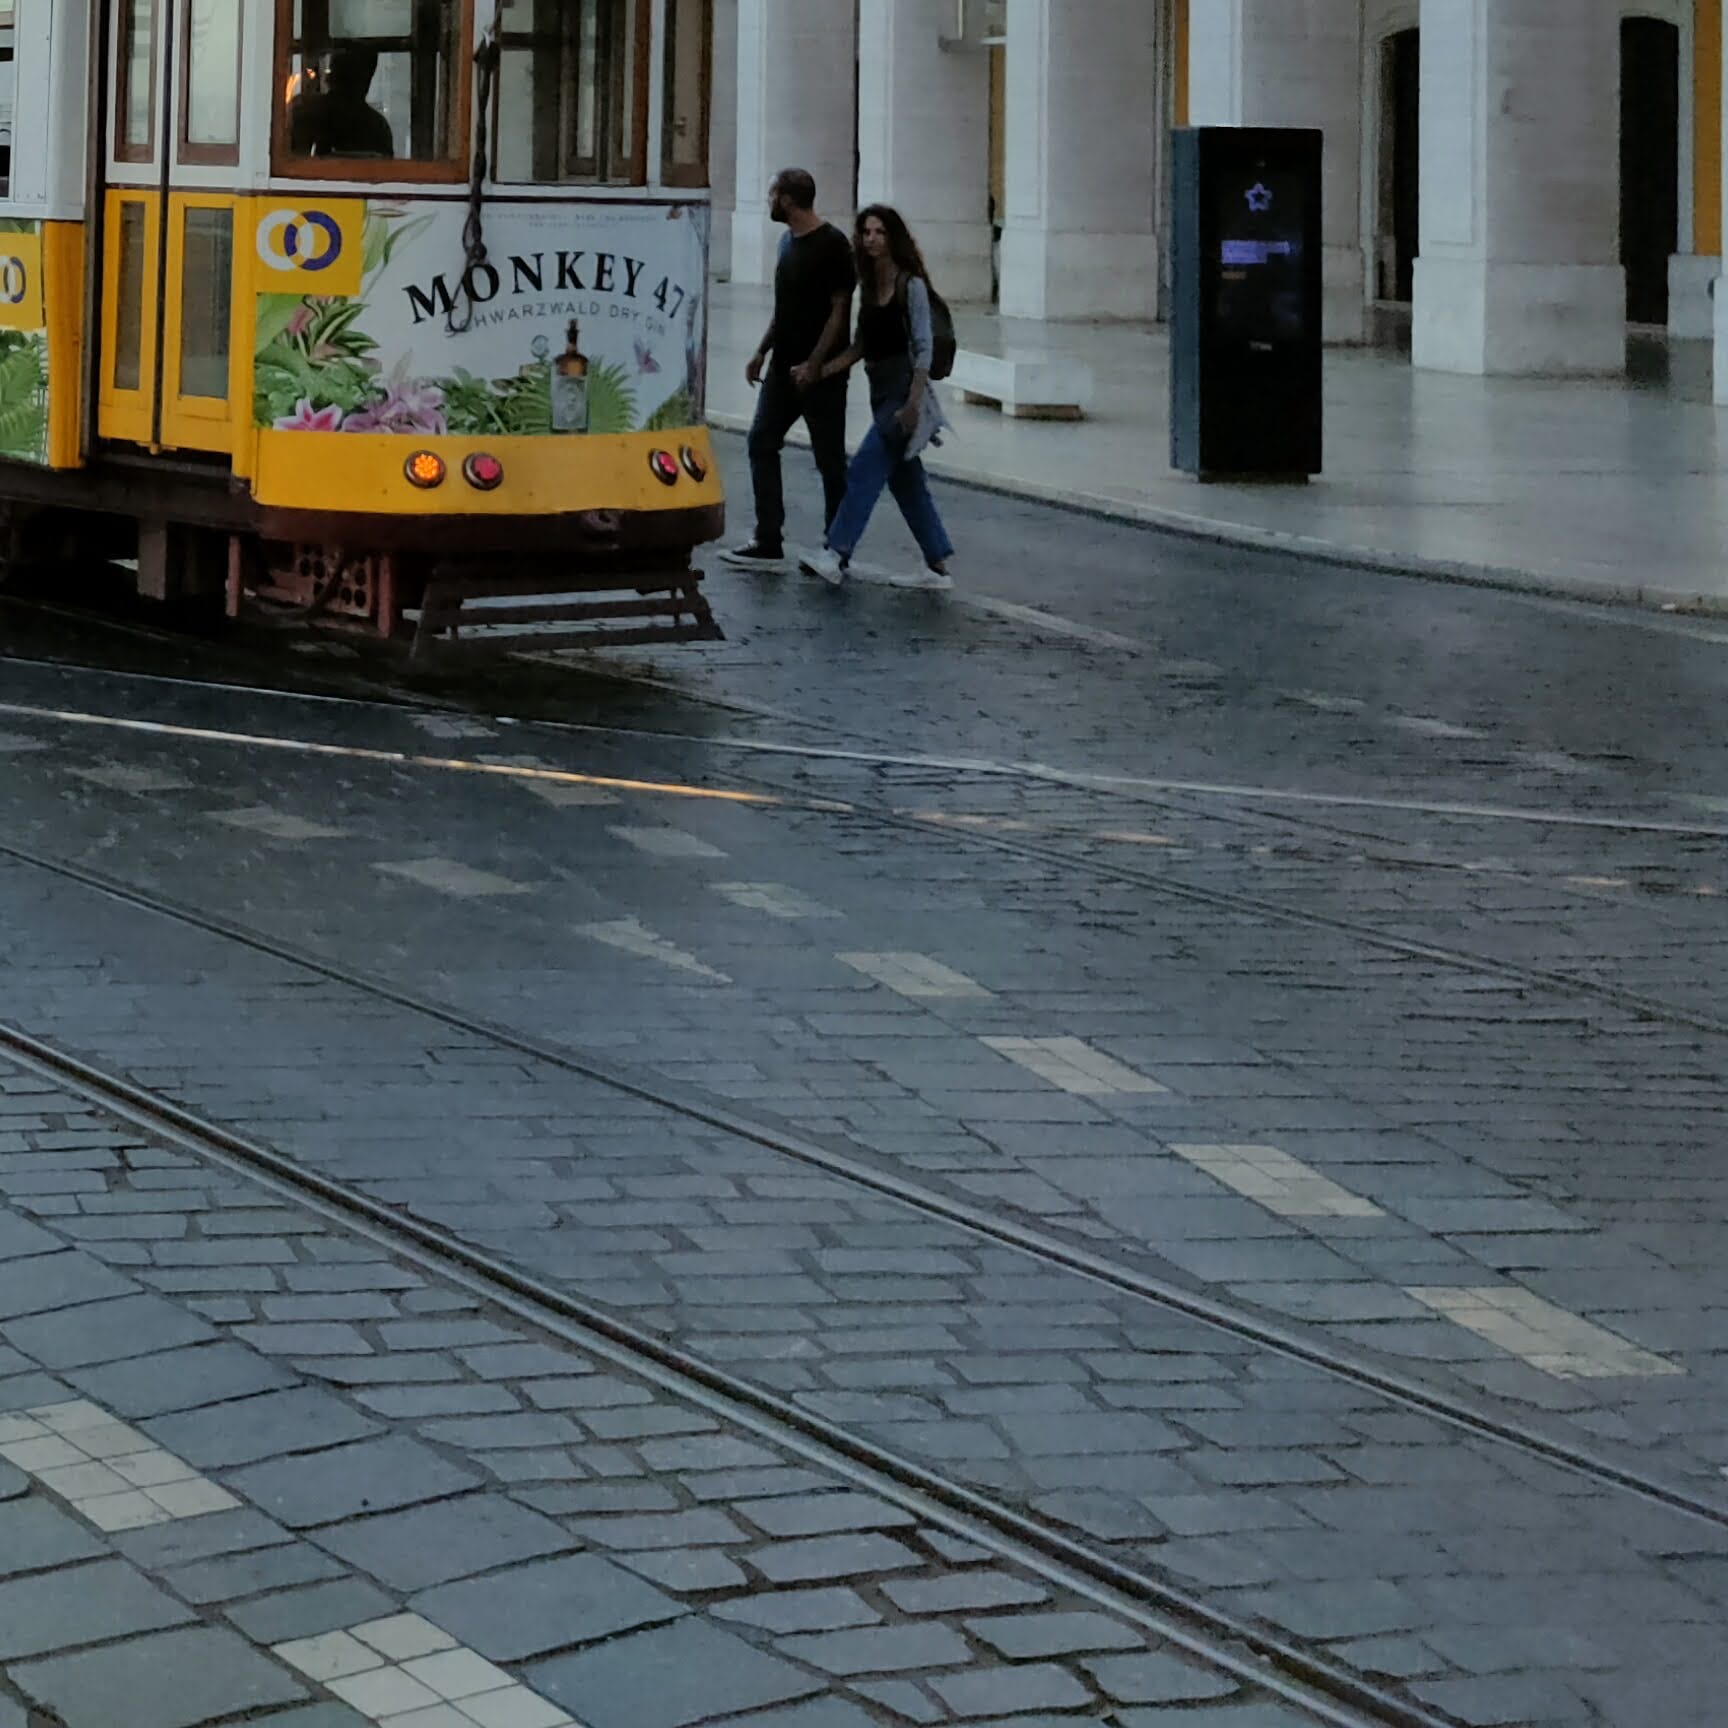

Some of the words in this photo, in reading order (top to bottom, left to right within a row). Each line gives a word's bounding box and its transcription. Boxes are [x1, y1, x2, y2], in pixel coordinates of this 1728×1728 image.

[402, 251, 645, 324] MONKEY
[654, 276, 685, 319] 47
[609, 303, 640, 321] DRY
